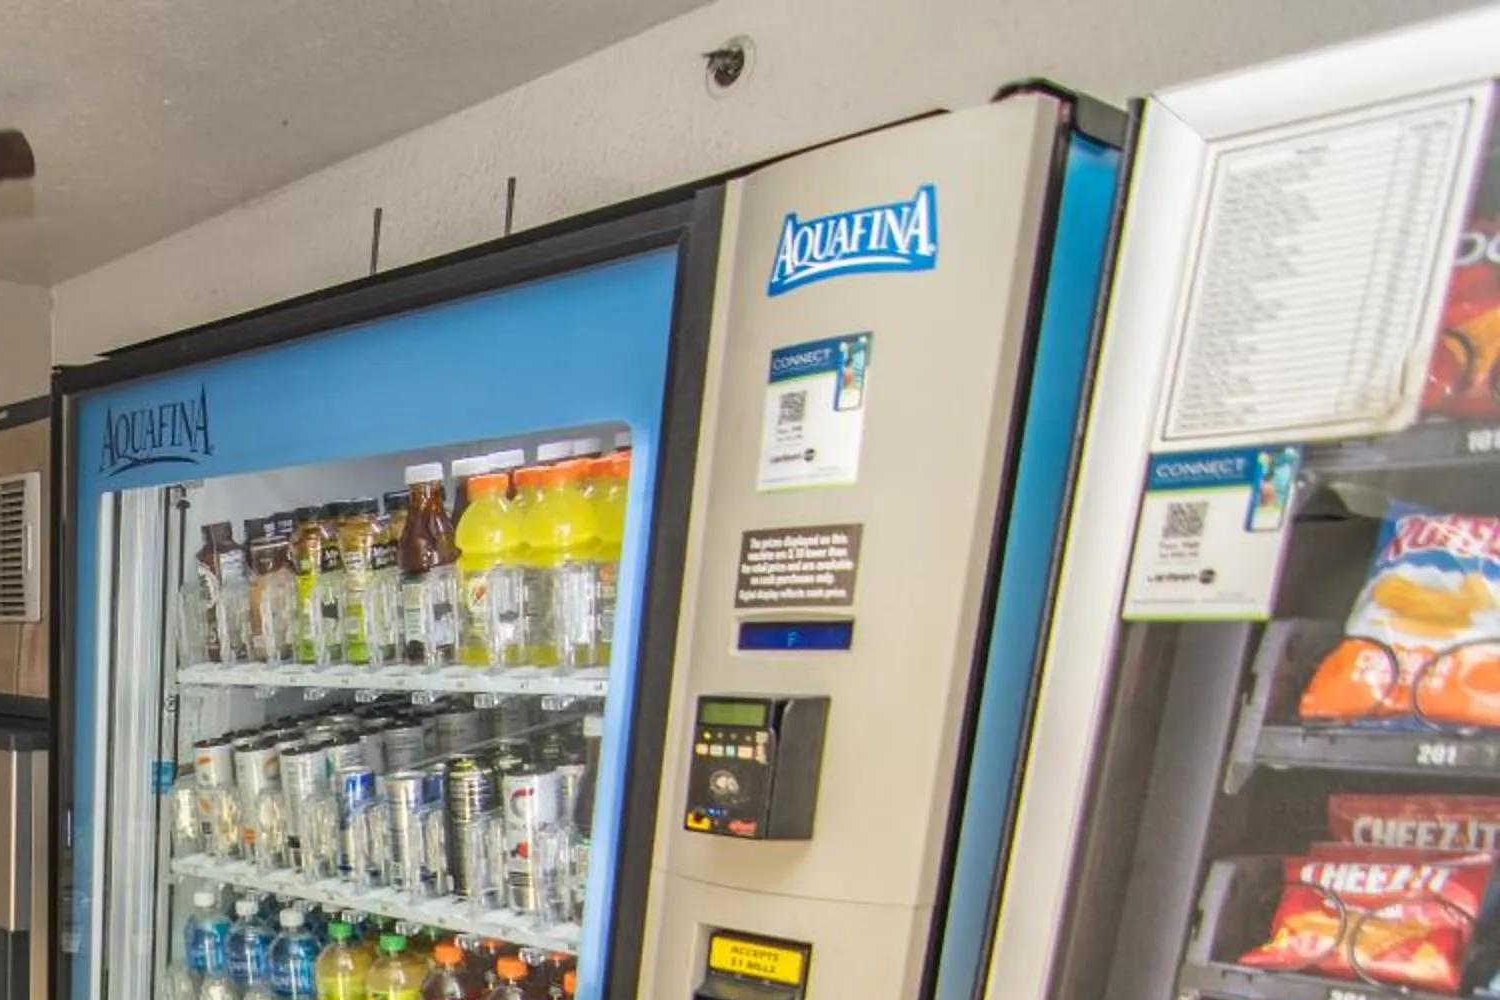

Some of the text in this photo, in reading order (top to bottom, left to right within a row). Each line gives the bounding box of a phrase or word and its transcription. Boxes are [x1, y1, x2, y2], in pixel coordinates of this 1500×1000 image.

[771, 189, 934, 283] AQUAFINA
[773, 348, 832, 370] CONNECT
[98, 382, 214, 473] AQUAFINA
[1155, 457, 1246, 478] CONNECT
[1416, 743, 1458, 766] 201
